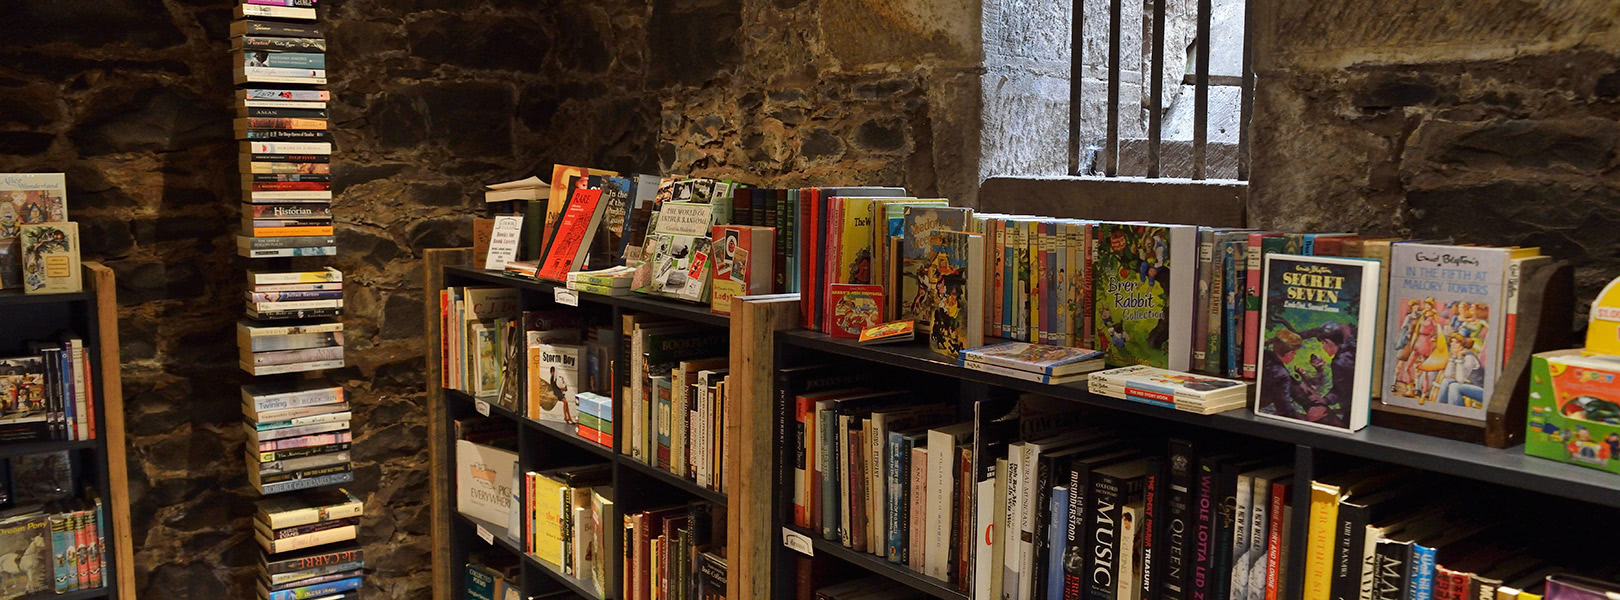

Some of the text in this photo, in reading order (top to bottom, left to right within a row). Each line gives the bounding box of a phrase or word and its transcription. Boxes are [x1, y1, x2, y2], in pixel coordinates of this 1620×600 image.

[573, 193, 591, 204] RARE
[274, 206, 312, 216] Historian
[1283, 272, 1345, 289] SECRET
[1405, 265, 1489, 282] IN THE FIFTH AT
[1107, 276, 1138, 293] Brer
[1402, 278, 1489, 296] MALORY TOWERS
[1114, 292, 1155, 310] Rabbit
[1287, 286, 1338, 304] SEVEN
[1122, 309, 1165, 322] Collection
[542, 351, 576, 367] Storm Boy
[259, 401, 287, 410] Twining
[264, 477, 330, 494] ROBERT GODDARD
[1147, 475, 1155, 490] THE
[1200, 475, 1211, 521] WHOLE
[1053, 501, 1061, 529] Karaoke
[1218, 495, 1236, 529] Clapton
[1237, 510, 1245, 525] NEW
[1254, 513, 1262, 527] NEW
[1092, 498, 1115, 587] MUSIC
[1170, 518, 1185, 579] QUEEN
[1197, 525, 1208, 562] LOTTA
[1268, 496, 1281, 589] DEBBIE HARRY AND BLONDIE
[1340, 521, 1352, 578] KIRI TE KANAWA
[1314, 529, 1326, 578] ARTHUR
[1143, 548, 1152, 592] TREASURY
[1411, 552, 1420, 577] RITA
[1195, 566, 1205, 588] LED
